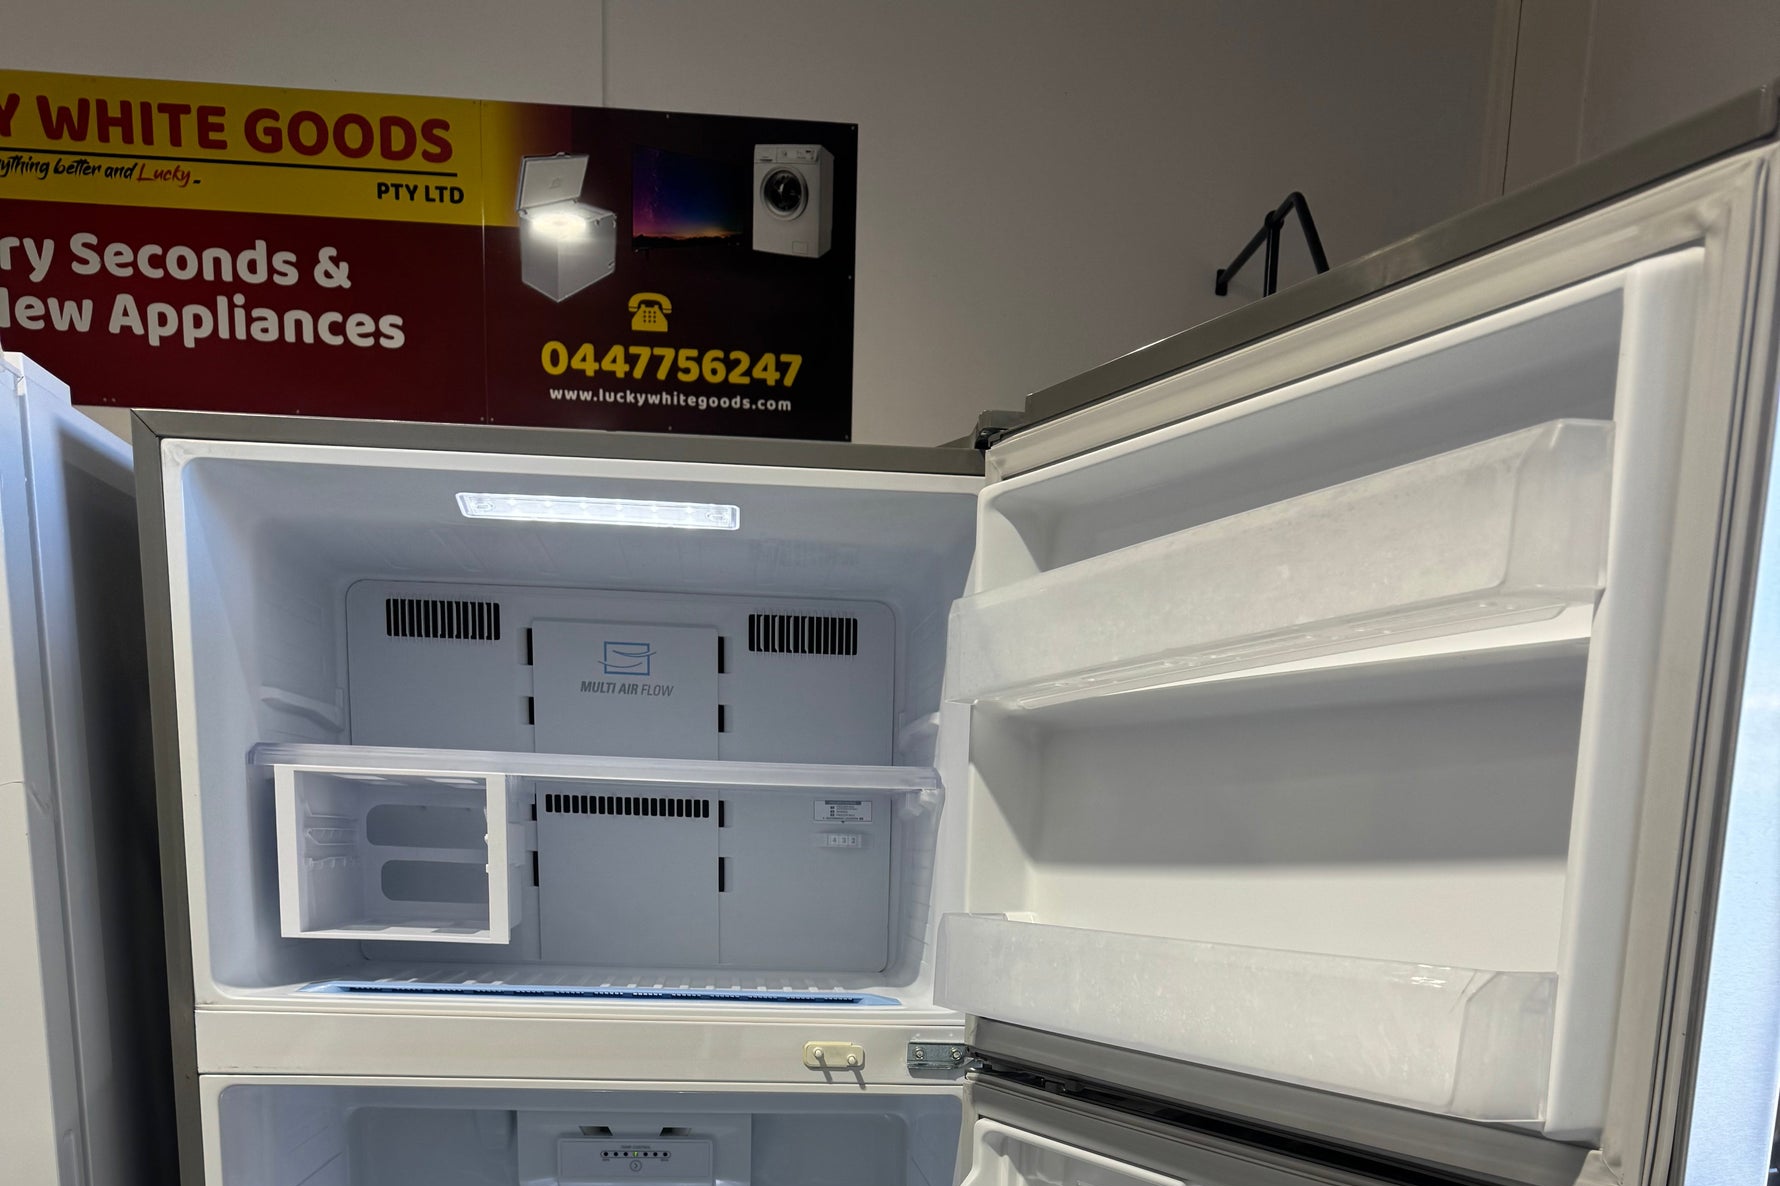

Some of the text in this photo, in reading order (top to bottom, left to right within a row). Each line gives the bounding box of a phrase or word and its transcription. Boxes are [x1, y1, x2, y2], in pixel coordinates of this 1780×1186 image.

[36, 95, 228, 150] WHITE
[243, 108, 454, 164] GOODS
[53, 157, 102, 177] better
[104, 163, 137, 180] and
[376, 181, 465, 204] PTY LTD
[69, 232, 299, 287] Seconds
[313, 246, 352, 289] &
[108, 293, 406, 349] Appliances
[541, 340, 802, 387] 0447756247
[549, 388, 792, 411] www.luckywhitegoods.com
[580, 680, 674, 697] MULTI AIR FLOW
